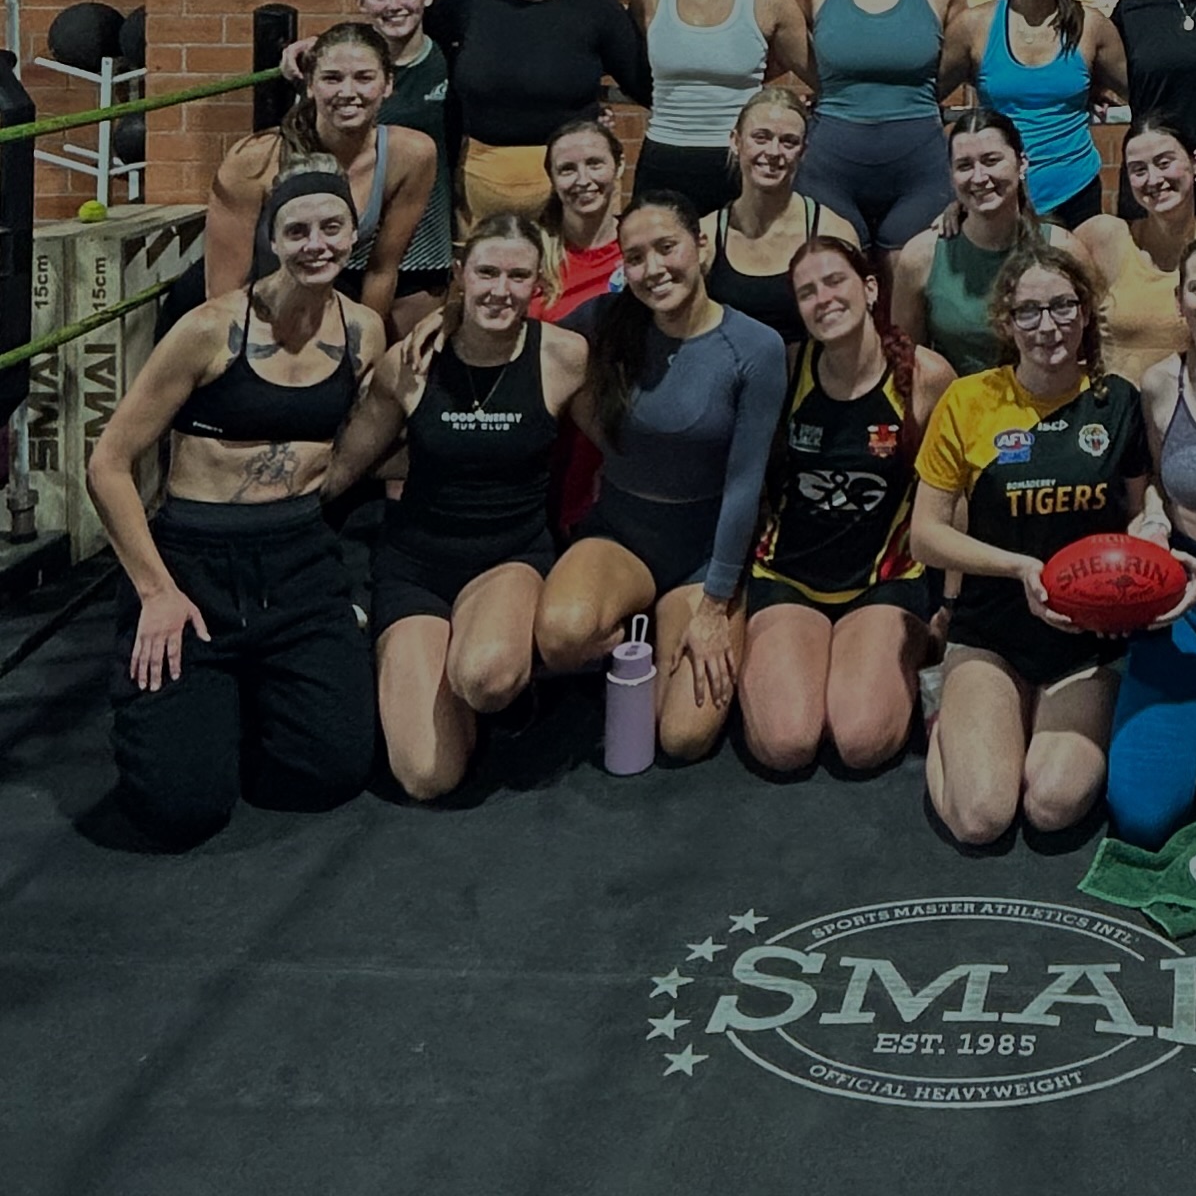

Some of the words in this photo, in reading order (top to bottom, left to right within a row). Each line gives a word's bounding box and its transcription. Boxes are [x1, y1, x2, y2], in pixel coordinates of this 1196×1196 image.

[35, 255, 49, 310] 15cm
[92, 257, 106, 311] 15cm
[84, 343, 116, 468] MAI
[440, 411, 476, 423] GOOD
[1005, 482, 1109, 518] TIGERS
[811, 909, 891, 940] SPORTS
[893, 902, 976, 920] MASTER
[979, 902, 1090, 930] ATHLETICS
[872, 1032, 946, 1055] EST.
[956, 1033, 1037, 1056] 1985
[808, 1063, 907, 1099] OFFICIAL
[913, 1070, 1084, 1101] HEAVYWEIGHT
